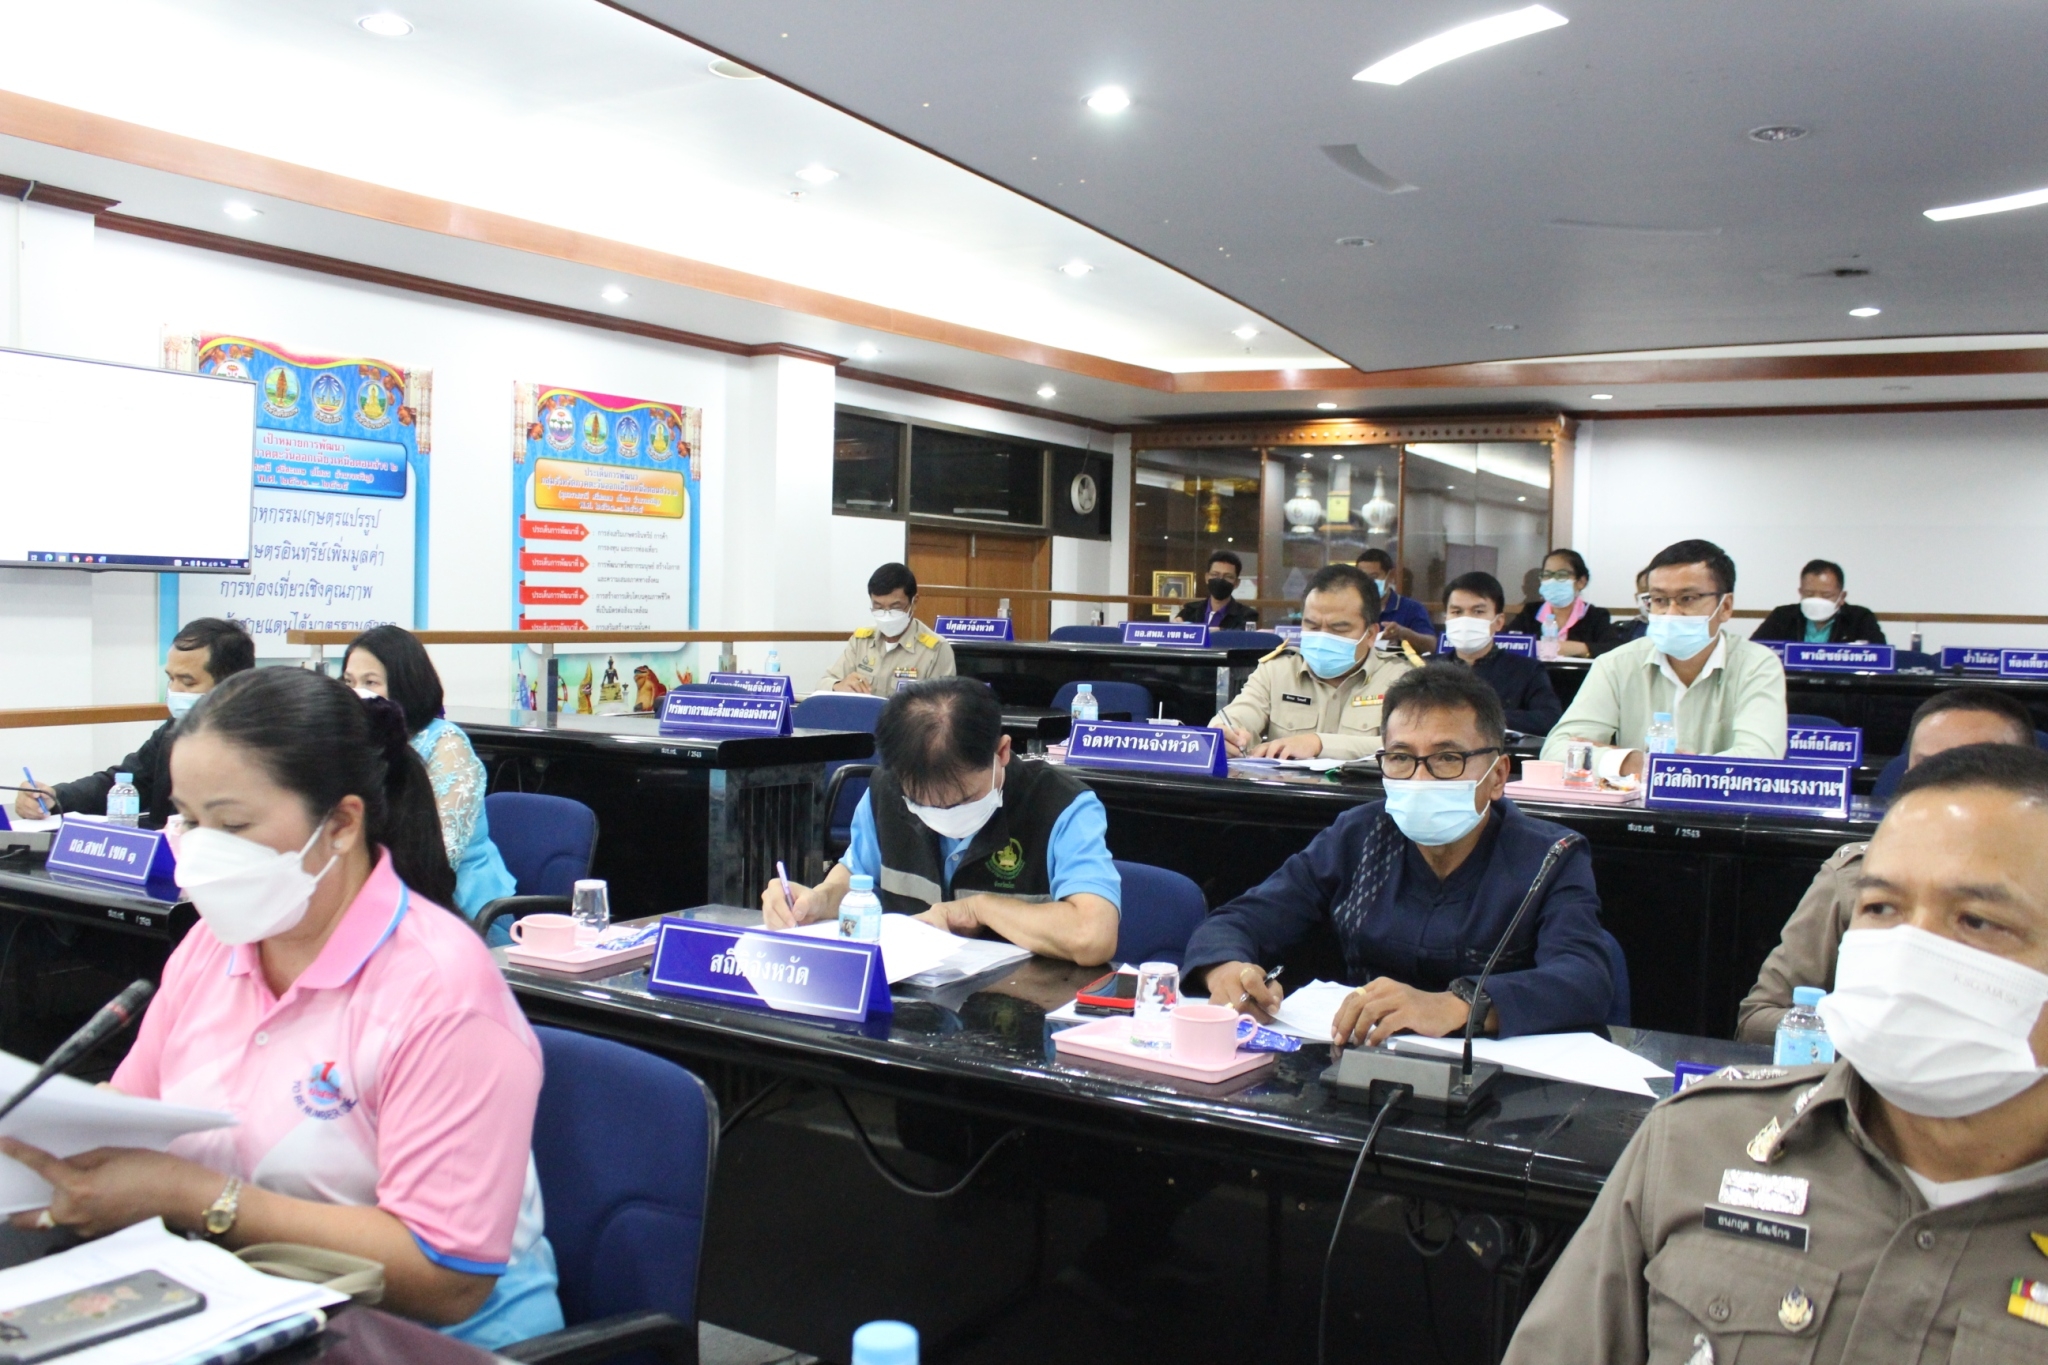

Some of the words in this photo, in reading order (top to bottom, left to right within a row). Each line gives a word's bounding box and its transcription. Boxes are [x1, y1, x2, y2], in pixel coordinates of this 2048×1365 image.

[263, 433, 345, 451] เป้าหมายการพัฒนา
[255, 447, 388, 470] าคตะวันออกเฉียงเหนือตอนล่าง
[253, 506, 381, 536] าหกรรมเกษตรแปรรูป
[252, 537, 385, 571] ษตรอินทรีย์เพิ่มมูลค่า
[220, 570, 373, 605] การท่องเที่ยวเชิงคุณภาพ
[945, 620, 995, 634] ปศุสัตว์จังหวัด
[1801, 648, 1878, 662] พาณิชย์จังหวัด
[1963, 649, 1999, 664] ป่าไม้จัง
[1082, 726, 1199, 753] จัดหางานจังหวัด
[1653, 766, 1843, 797] สวัสดิการคุ้มครองแรงงานฯ
[69, 837, 106, 857] ผอ.สพป.
[108, 845, 128, 861] เขต
[710, 948, 809, 986] สถิติจังหวัด
